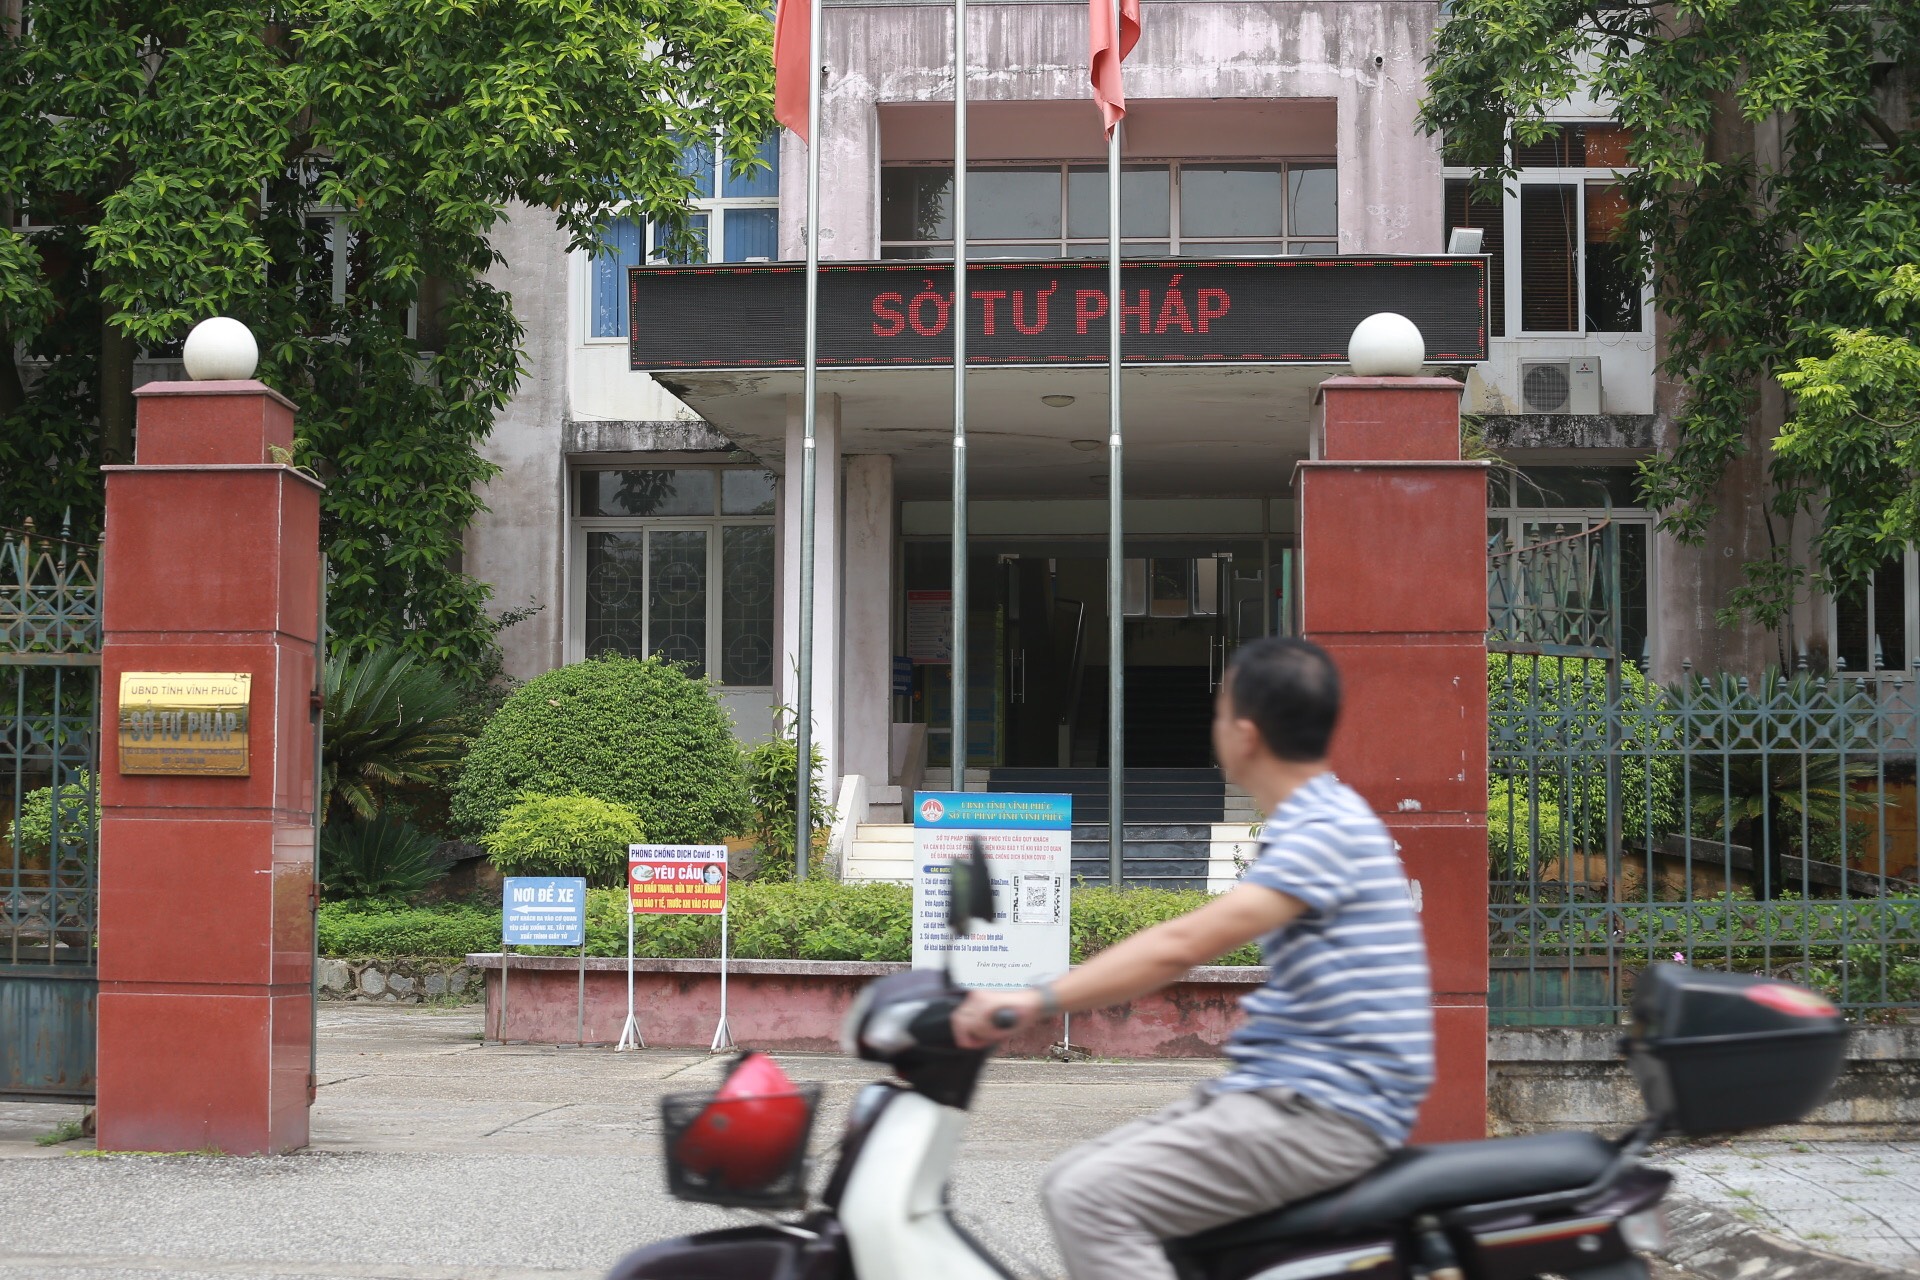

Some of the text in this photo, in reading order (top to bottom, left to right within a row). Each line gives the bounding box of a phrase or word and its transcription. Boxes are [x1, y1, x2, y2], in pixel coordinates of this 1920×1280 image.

[872, 274, 1230, 336] SỞ TƯ PHÁP
[131, 684, 238, 695] UBND TỈNH VĨNH PHÚC
[130, 699, 237, 741] SỞ TƯ PHÁP
[631, 847, 652, 858] PHÒNG
[654, 846, 675, 858] CHỐNG
[677, 849, 691, 860] DỊCH
[693, 849, 710, 858] Covid
[717, 850, 724, 858] 19
[654, 864, 701, 880] YÊU CẦU
[513, 881, 574, 902] NƠI ĐỂ XE
